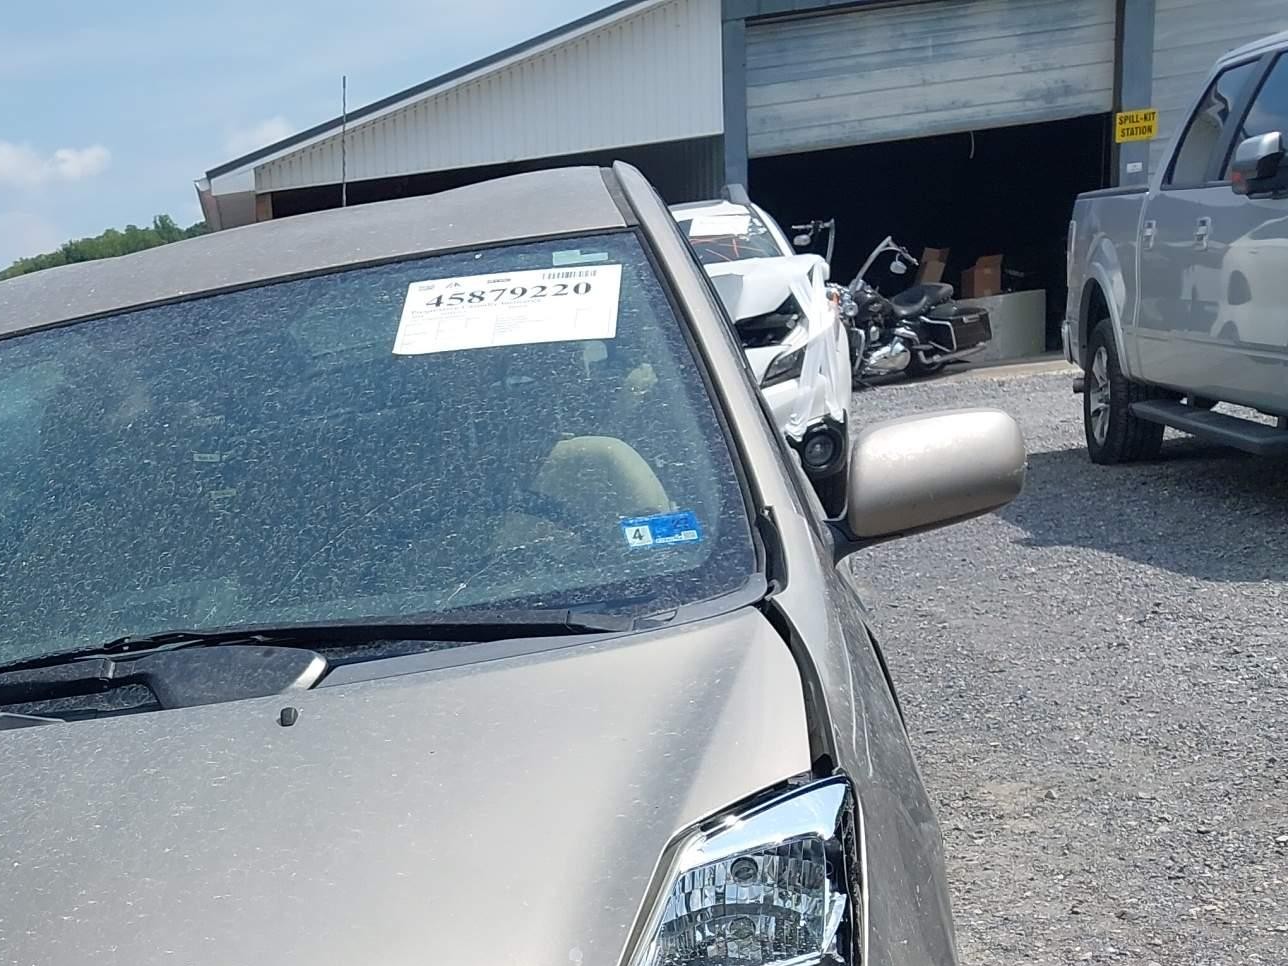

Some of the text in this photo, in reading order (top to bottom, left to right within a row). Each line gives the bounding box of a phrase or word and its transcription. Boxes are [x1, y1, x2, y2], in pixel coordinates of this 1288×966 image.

[1118, 111, 1156, 125] SPILL-KIT
[1120, 125, 1153, 137] STATION
[425, 280, 592, 308] 45879220
[632, 528, 643, 541] 4
